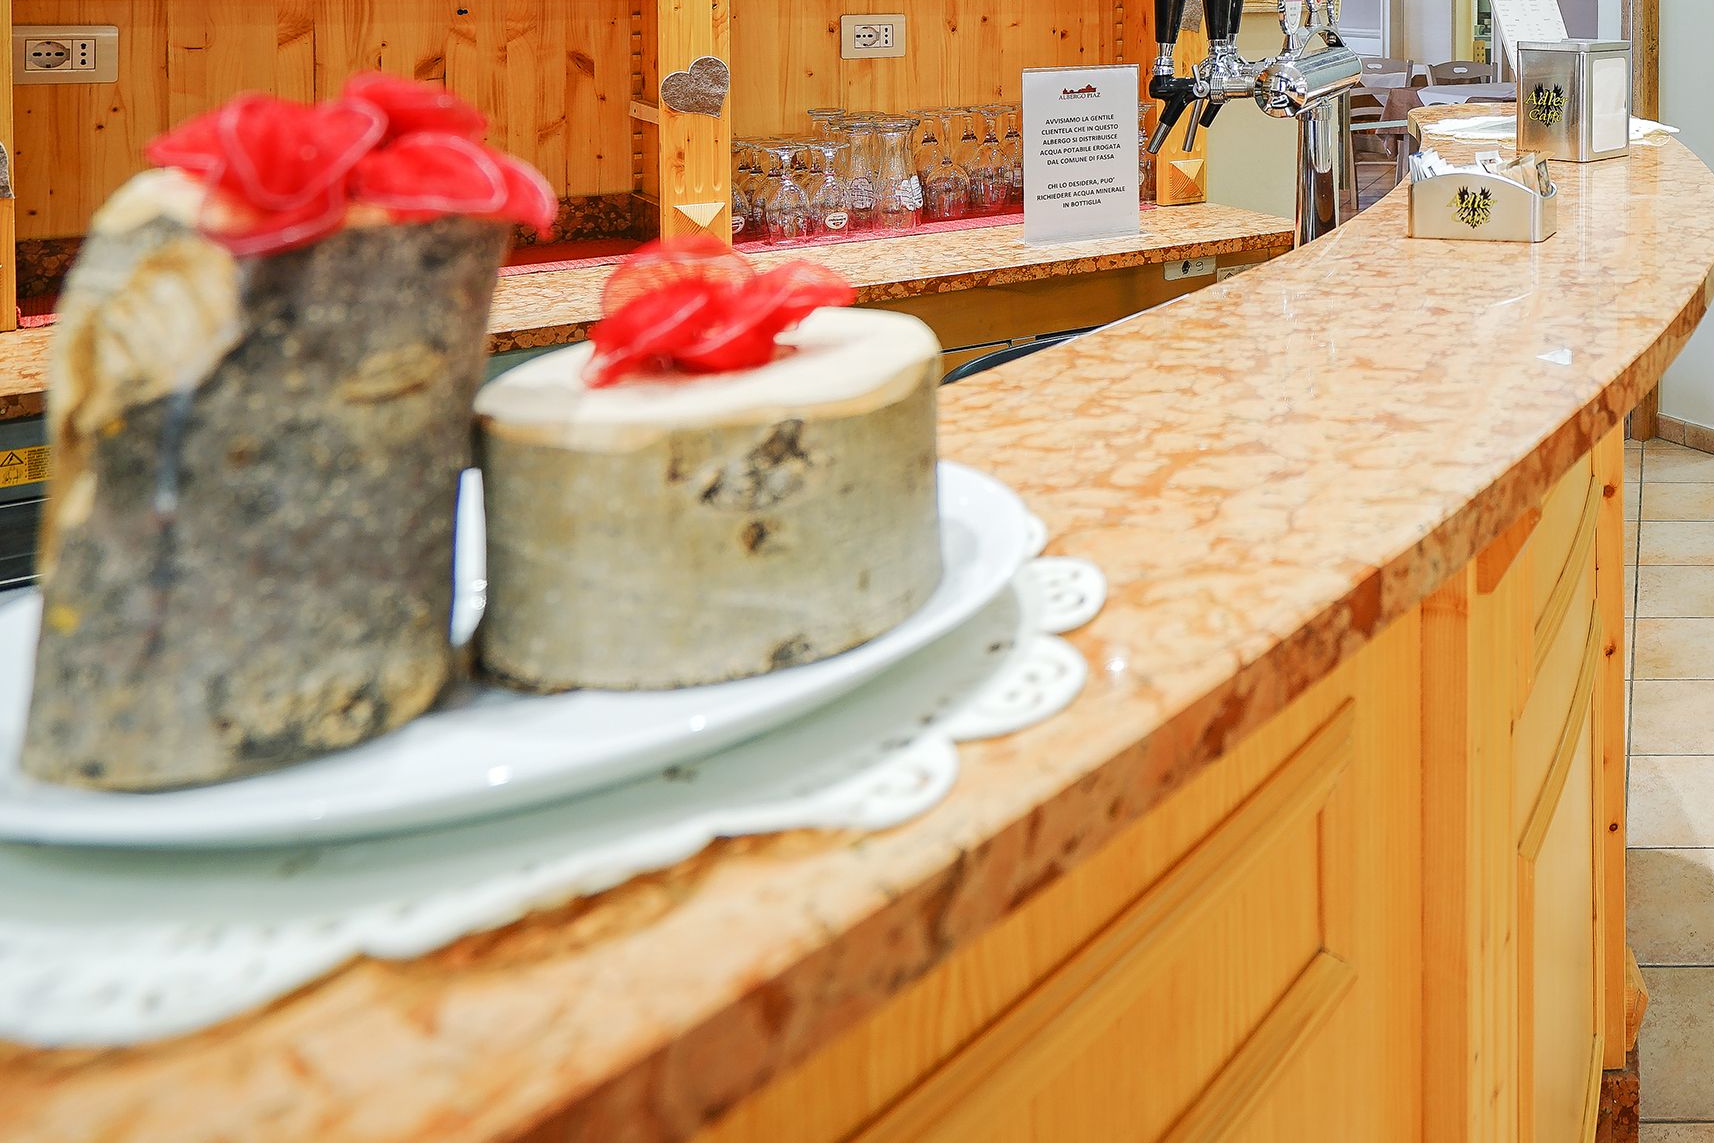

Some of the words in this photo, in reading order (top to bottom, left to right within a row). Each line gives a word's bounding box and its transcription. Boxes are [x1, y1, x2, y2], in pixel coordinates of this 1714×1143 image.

[1524, 90, 1569, 107] Adler
[1045, 116, 1081, 125] AVVISIAMO
[1041, 127, 1073, 136] CLIENTELA
[1094, 123, 1119, 131] QUESTO
[1042, 137, 1071, 146] ALBERGO
[1078, 133, 1118, 143] DISTRIBUISCE
[1040, 148, 1062, 156] ACQUA
[1063, 145, 1091, 154] POTABILE
[1092, 143, 1121, 151] EROGATA
[1060, 156, 1088, 165] COMUNE
[1096, 153, 1115, 161] FASSA
[1068, 179, 1099, 188] DESIDERA,
[1100, 176, 1115, 184] PUO'
[1036, 191, 1072, 201] RICHIEDERE
[1073, 189, 1095, 197] ACQUA
[1095, 186, 1126, 194] MINERALE
[1070, 198, 1102, 207] BOTTIGLIA
